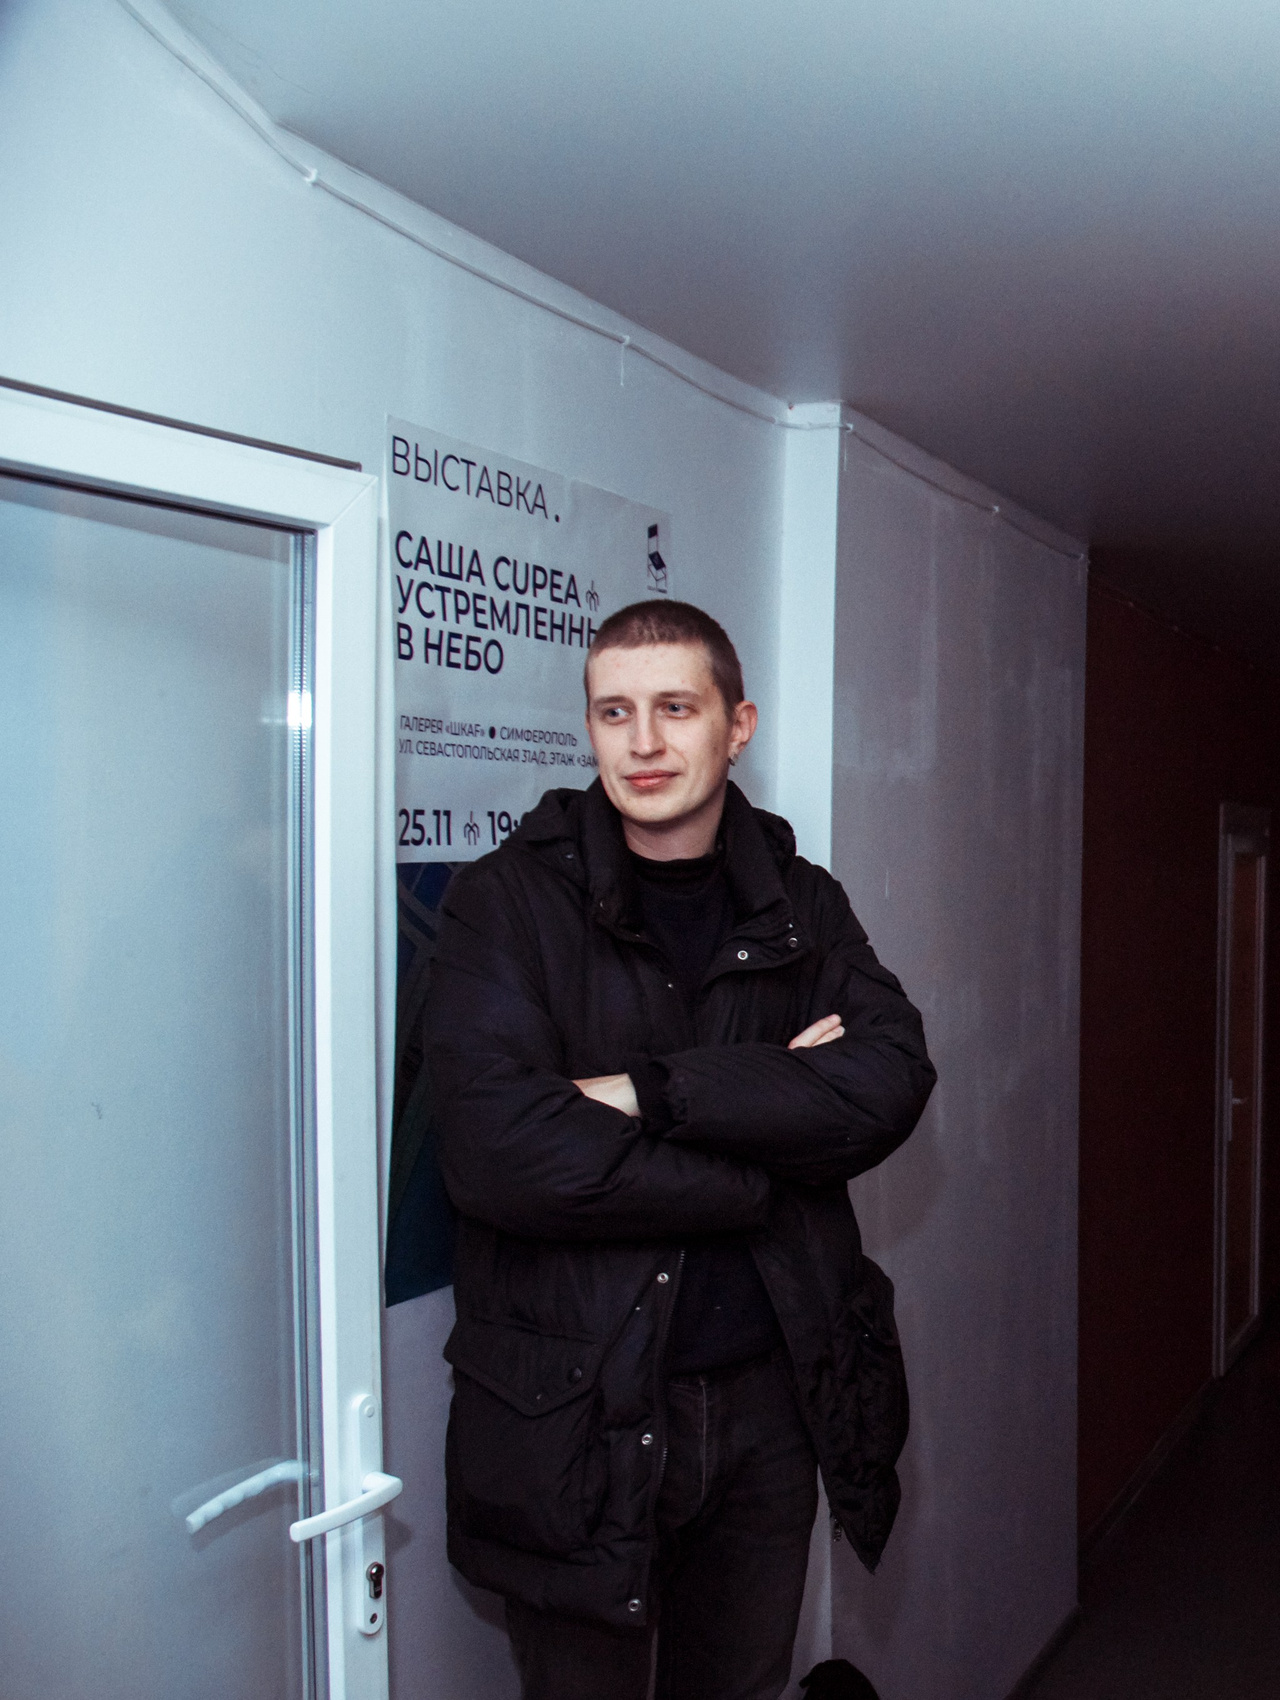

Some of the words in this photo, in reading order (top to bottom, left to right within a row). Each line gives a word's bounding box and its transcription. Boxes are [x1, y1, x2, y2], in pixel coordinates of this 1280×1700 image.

[395, 530, 486, 586] САША
[397, 621, 414, 661] В
[424, 627, 504, 674] НЕБО
[400, 715, 443, 734] ГАЛЕРЕЯ
[500, 726, 578, 747] СИМФЕРОПОЛЬ
[416, 740, 519, 762] СЕВАСТОПОЛЬСКАЯ
[549, 751, 575, 766] ЭТАЖ
[398, 808, 452, 846] 25.11
